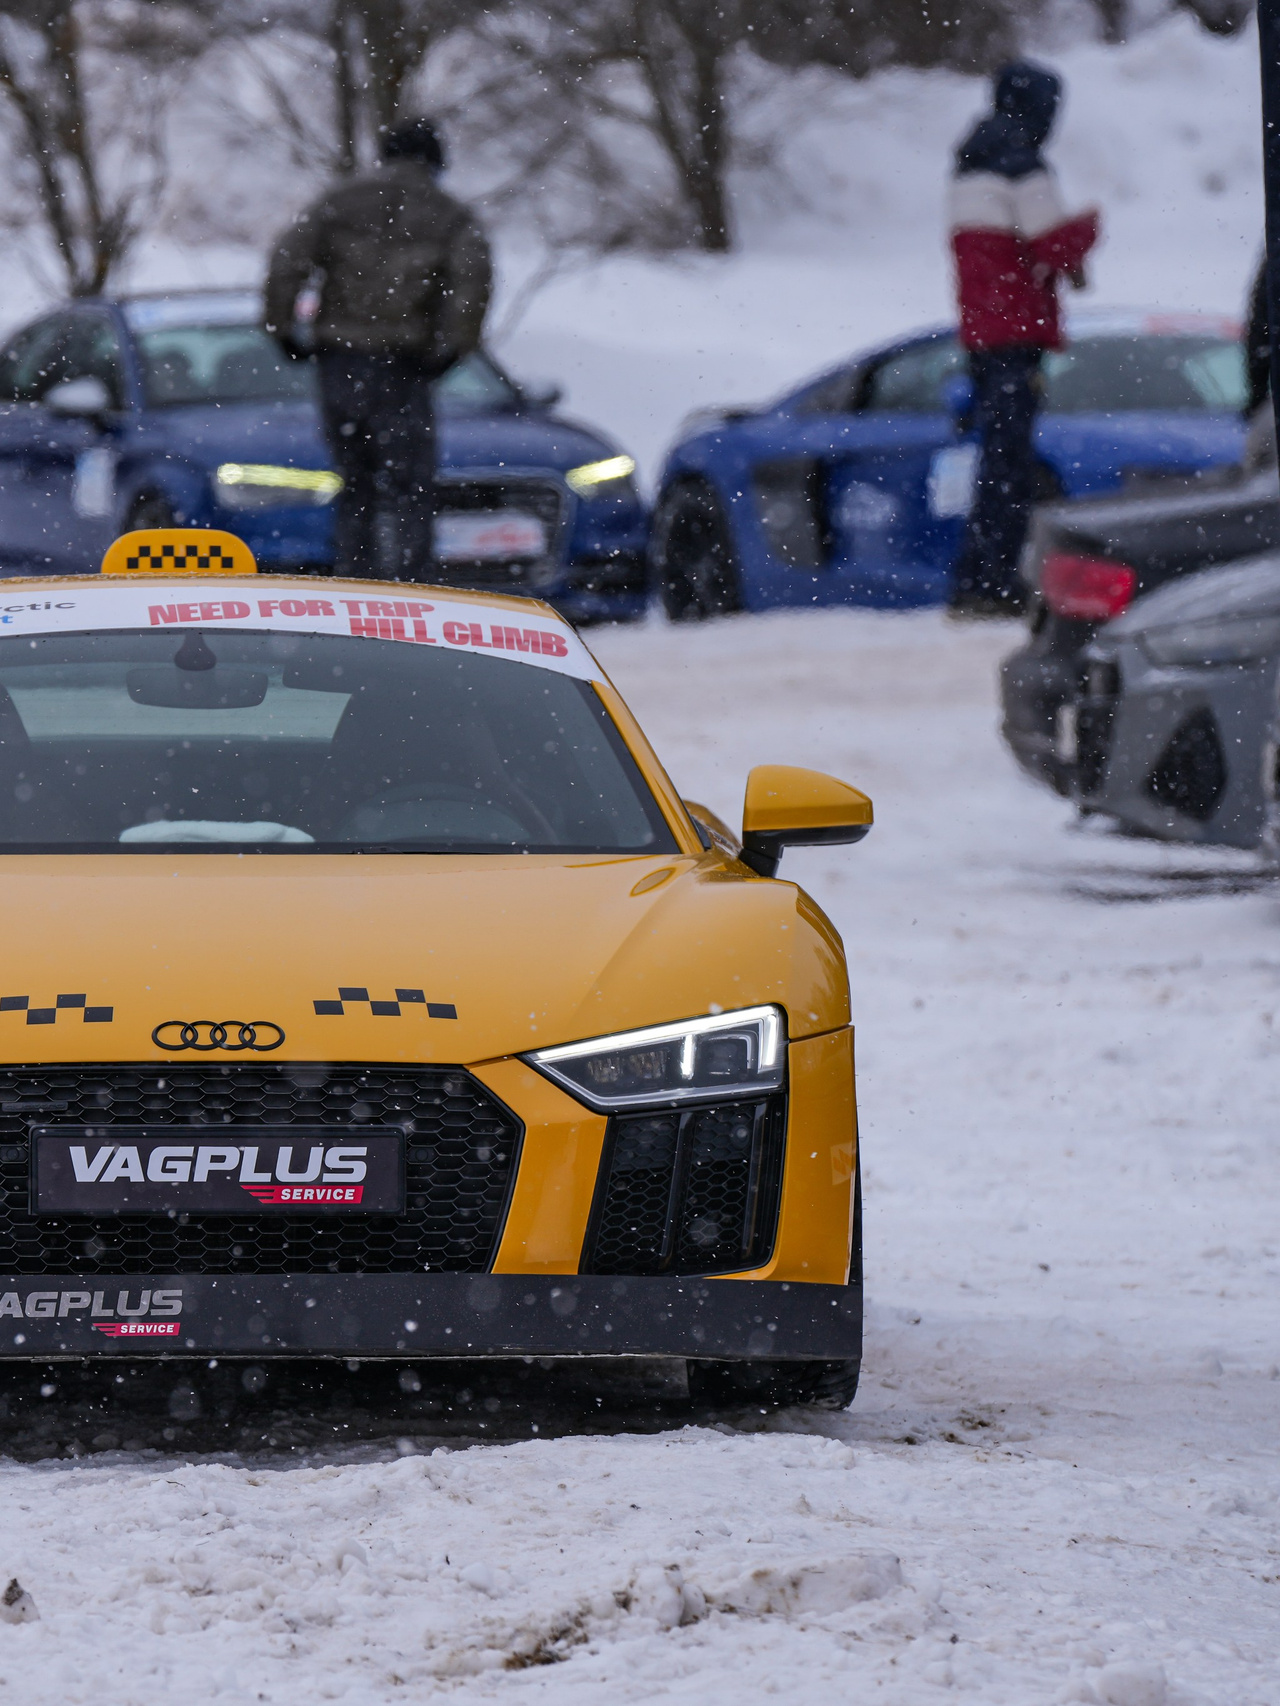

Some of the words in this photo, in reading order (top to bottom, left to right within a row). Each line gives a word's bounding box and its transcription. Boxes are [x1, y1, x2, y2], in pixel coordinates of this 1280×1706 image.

[148, 601, 251, 626] NEED
[258, 600, 335, 618] FOR
[339, 600, 435, 618] TRIP
[349, 617, 436, 644] HILL
[443, 621, 569, 658] CLIMB
[69, 1146, 368, 1183] VAGPLUS
[280, 1188, 356, 1201] SERVICE
[120, 1324, 175, 1334] SERVICE
